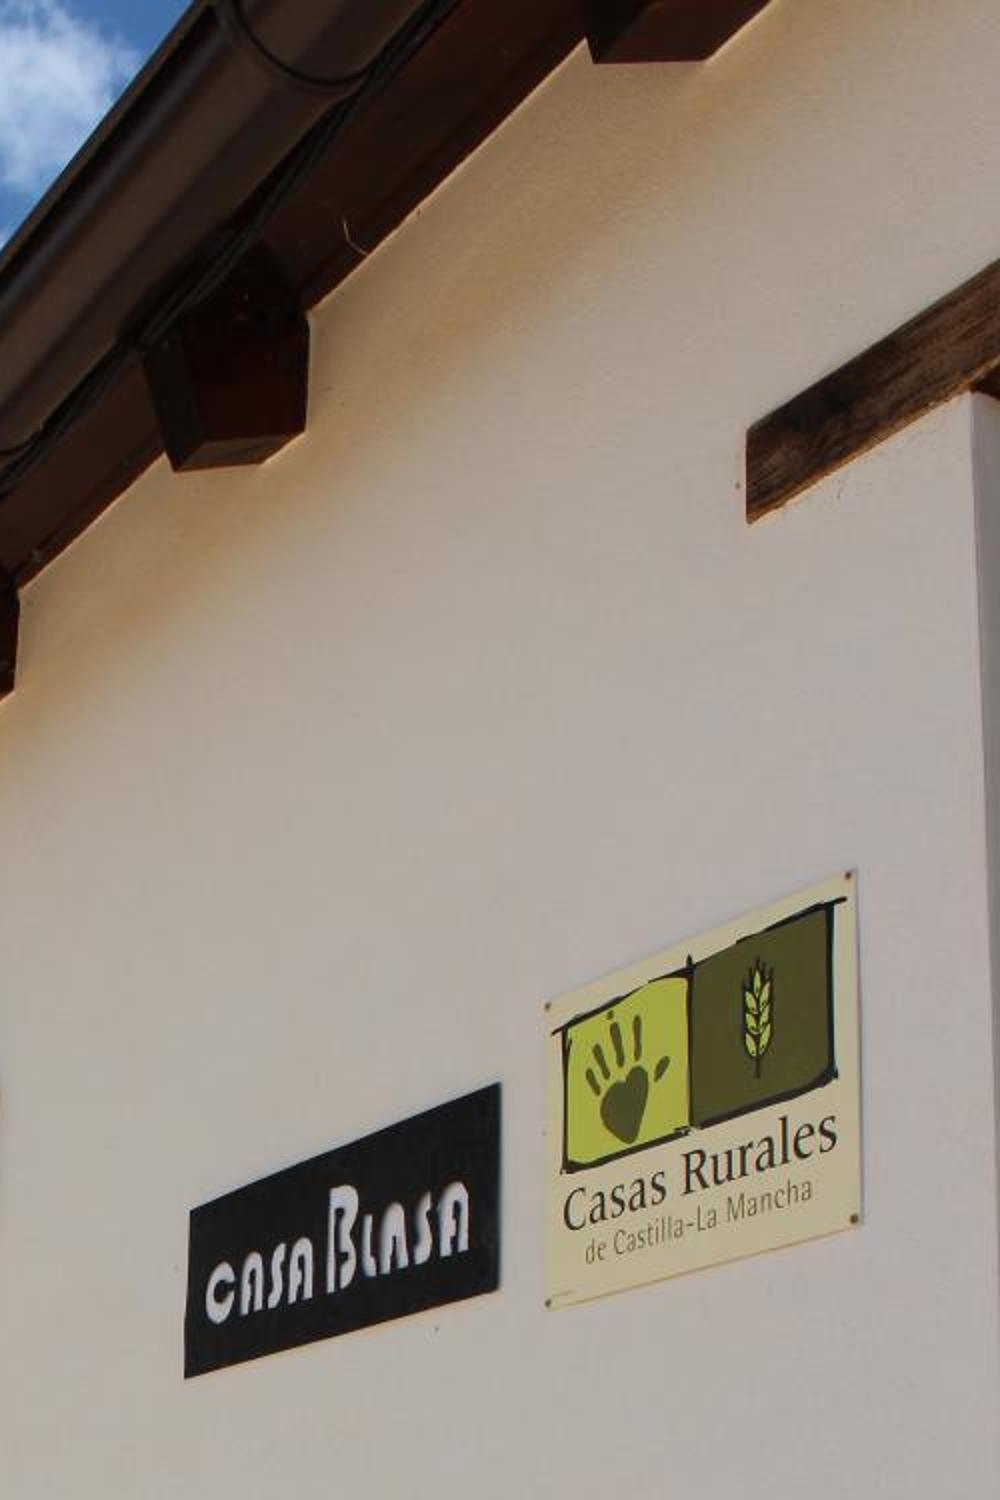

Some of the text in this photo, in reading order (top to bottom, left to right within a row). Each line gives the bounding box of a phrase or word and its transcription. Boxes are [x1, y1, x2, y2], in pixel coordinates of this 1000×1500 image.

[562, 1113, 839, 1232] Casas Rurales
[585, 1236, 606, 1265] de
[727, 1178, 813, 1223] Mancha
